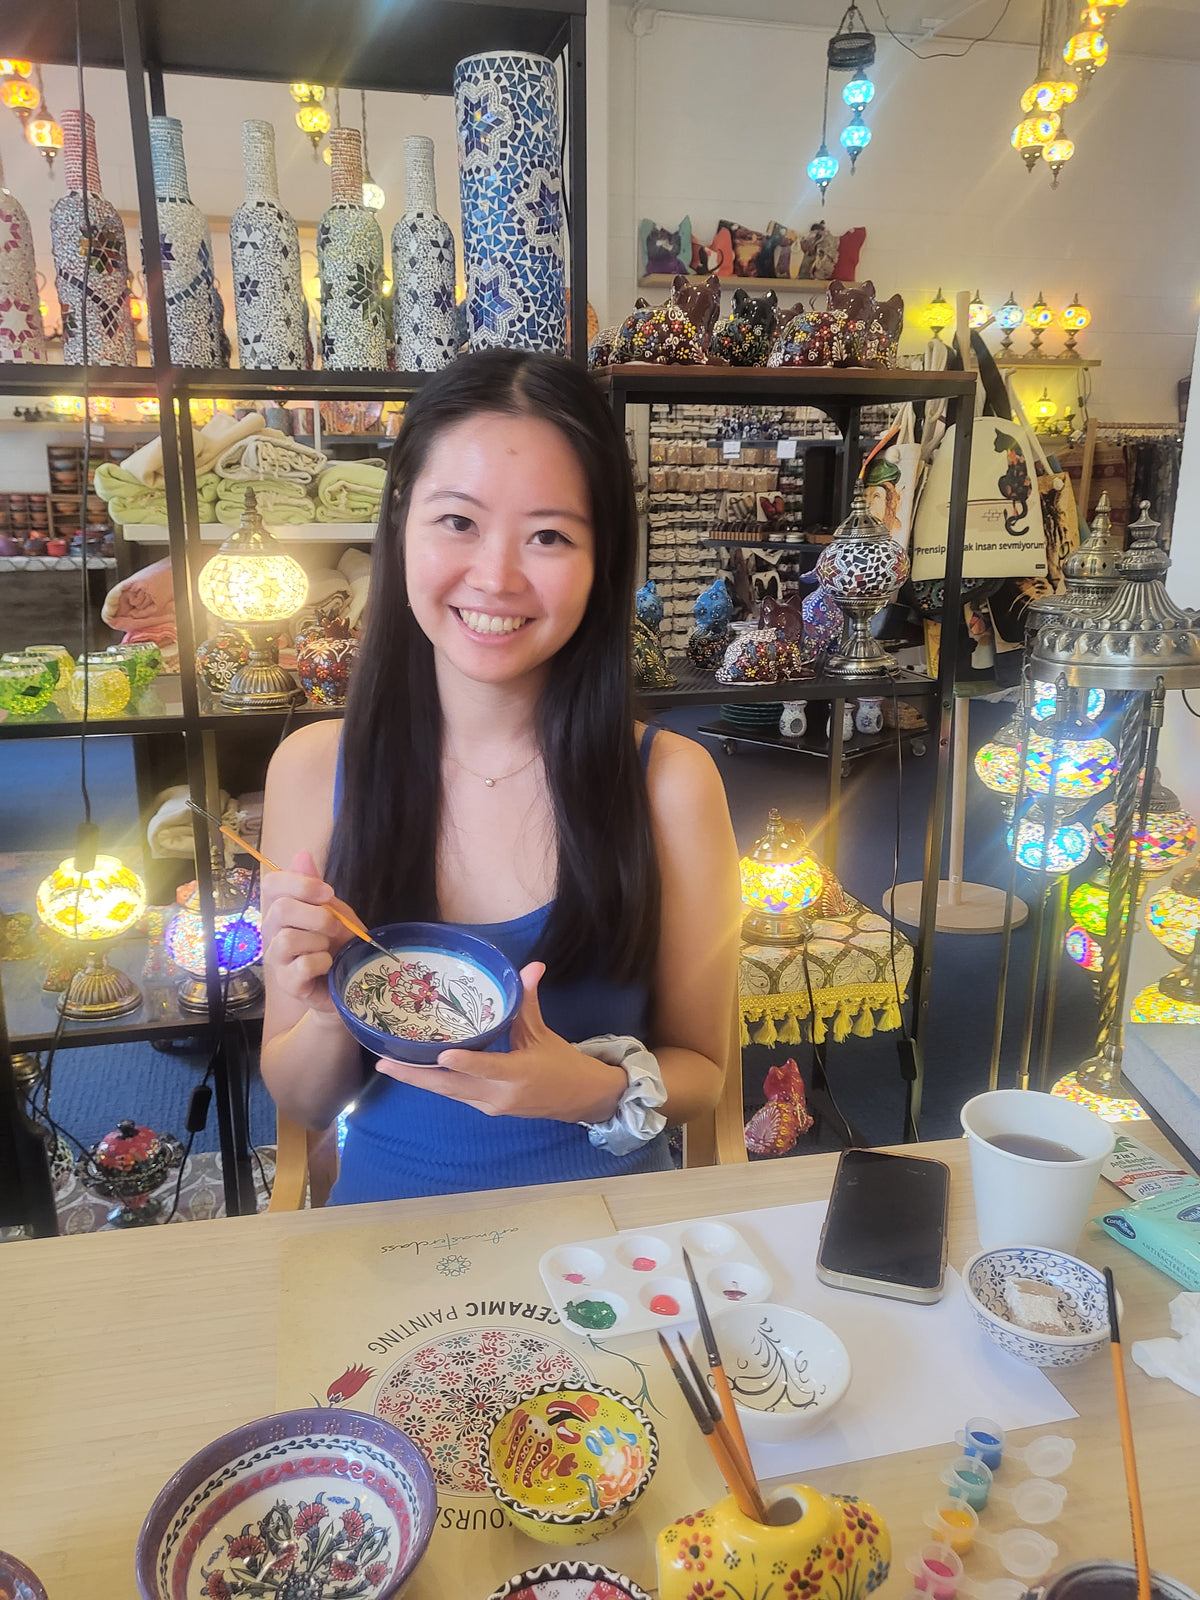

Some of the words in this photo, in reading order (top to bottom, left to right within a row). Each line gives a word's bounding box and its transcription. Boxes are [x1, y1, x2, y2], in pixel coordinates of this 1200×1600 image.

[975, 542, 997, 551] insan
[380, 1227, 519, 1255] artmasterclass
[465, 1300, 562, 1326] CERAMIC
[367, 1304, 459, 1355] PAINTING
[436, 1506, 513, 1530] OURS
